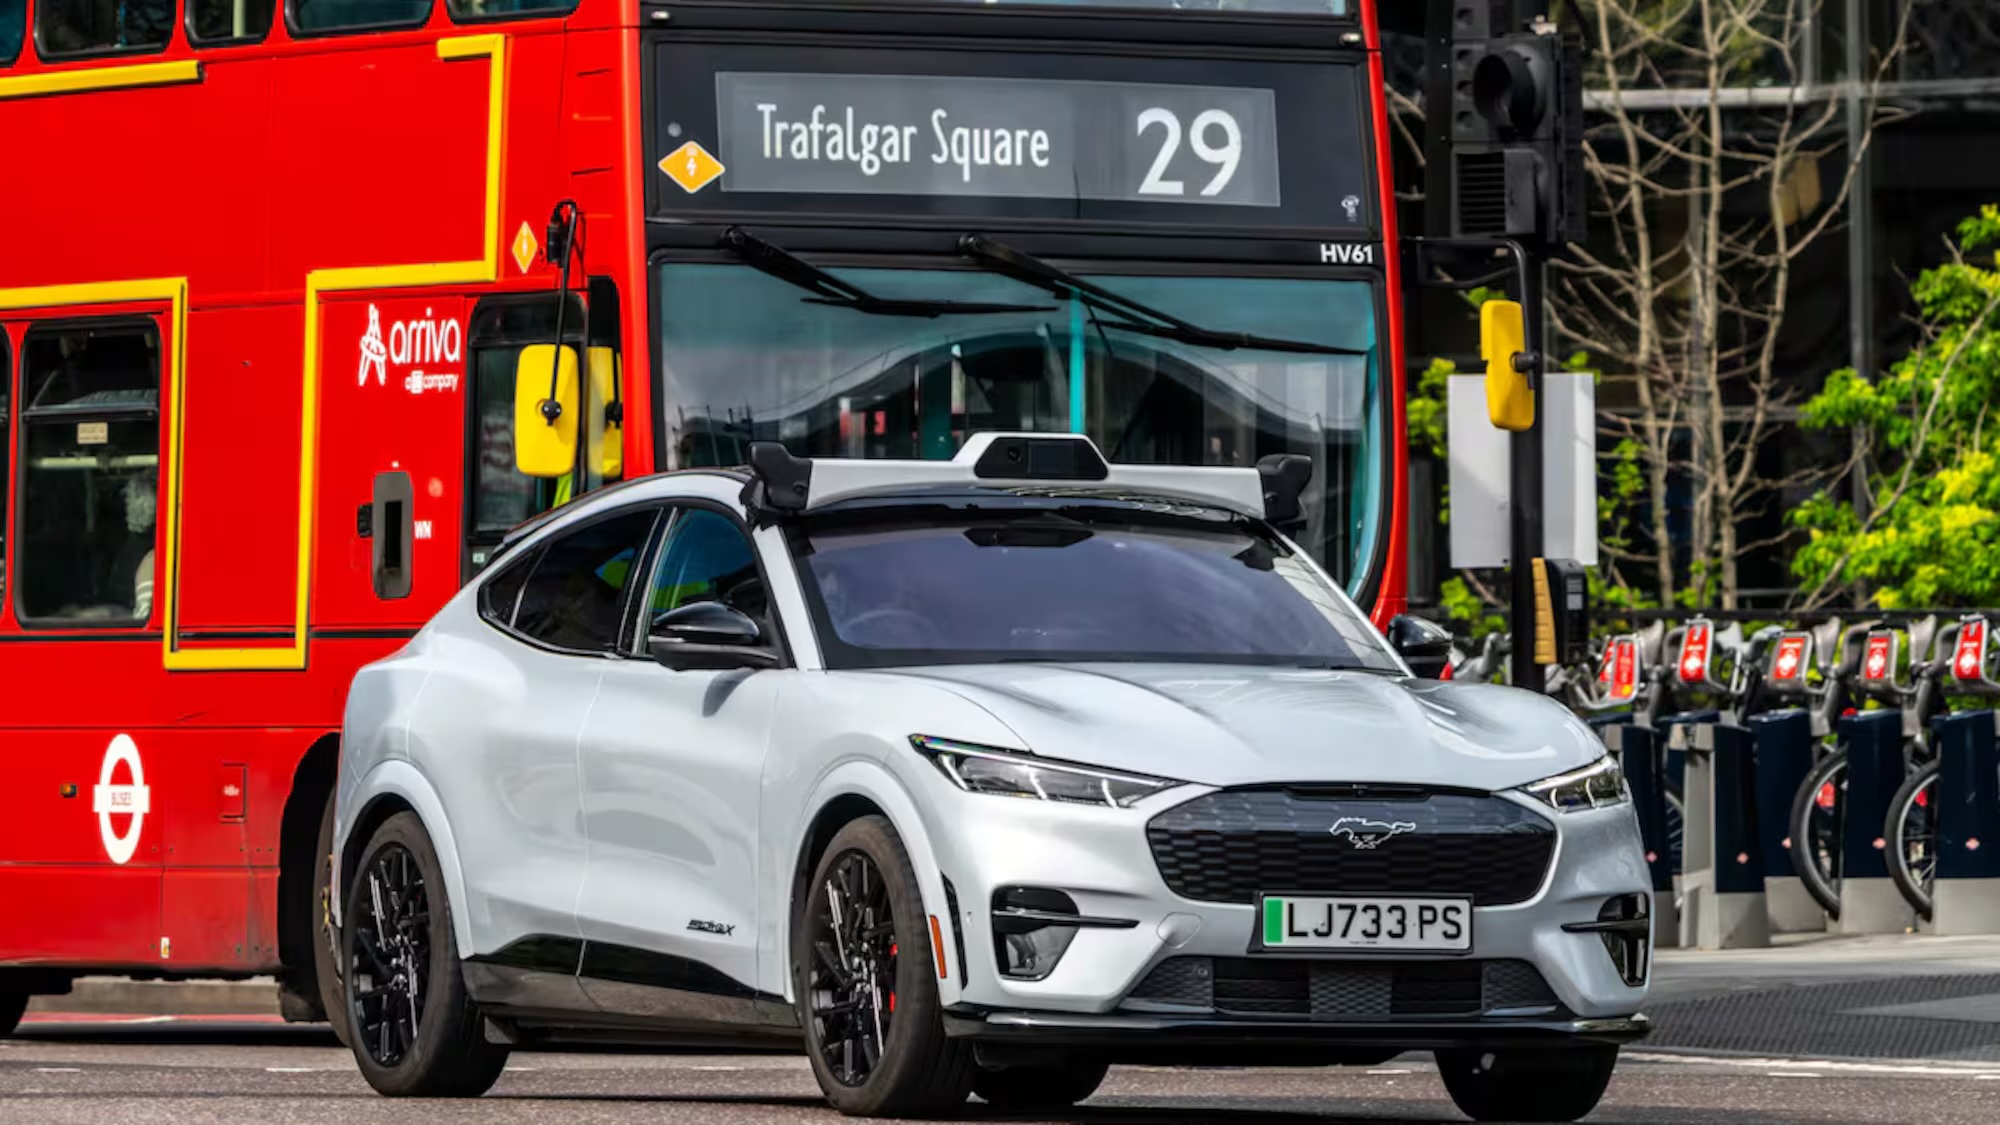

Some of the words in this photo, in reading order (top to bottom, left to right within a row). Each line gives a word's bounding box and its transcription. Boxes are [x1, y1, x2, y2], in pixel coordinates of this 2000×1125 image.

[757, 103, 918, 175] Trafalgar
[931, 108, 1050, 182] Square
[1137, 107, 1242, 196] 29
[1320, 243, 1373, 264] HV61
[389, 307, 461, 365] arriva
[414, 520, 432, 539] WN
